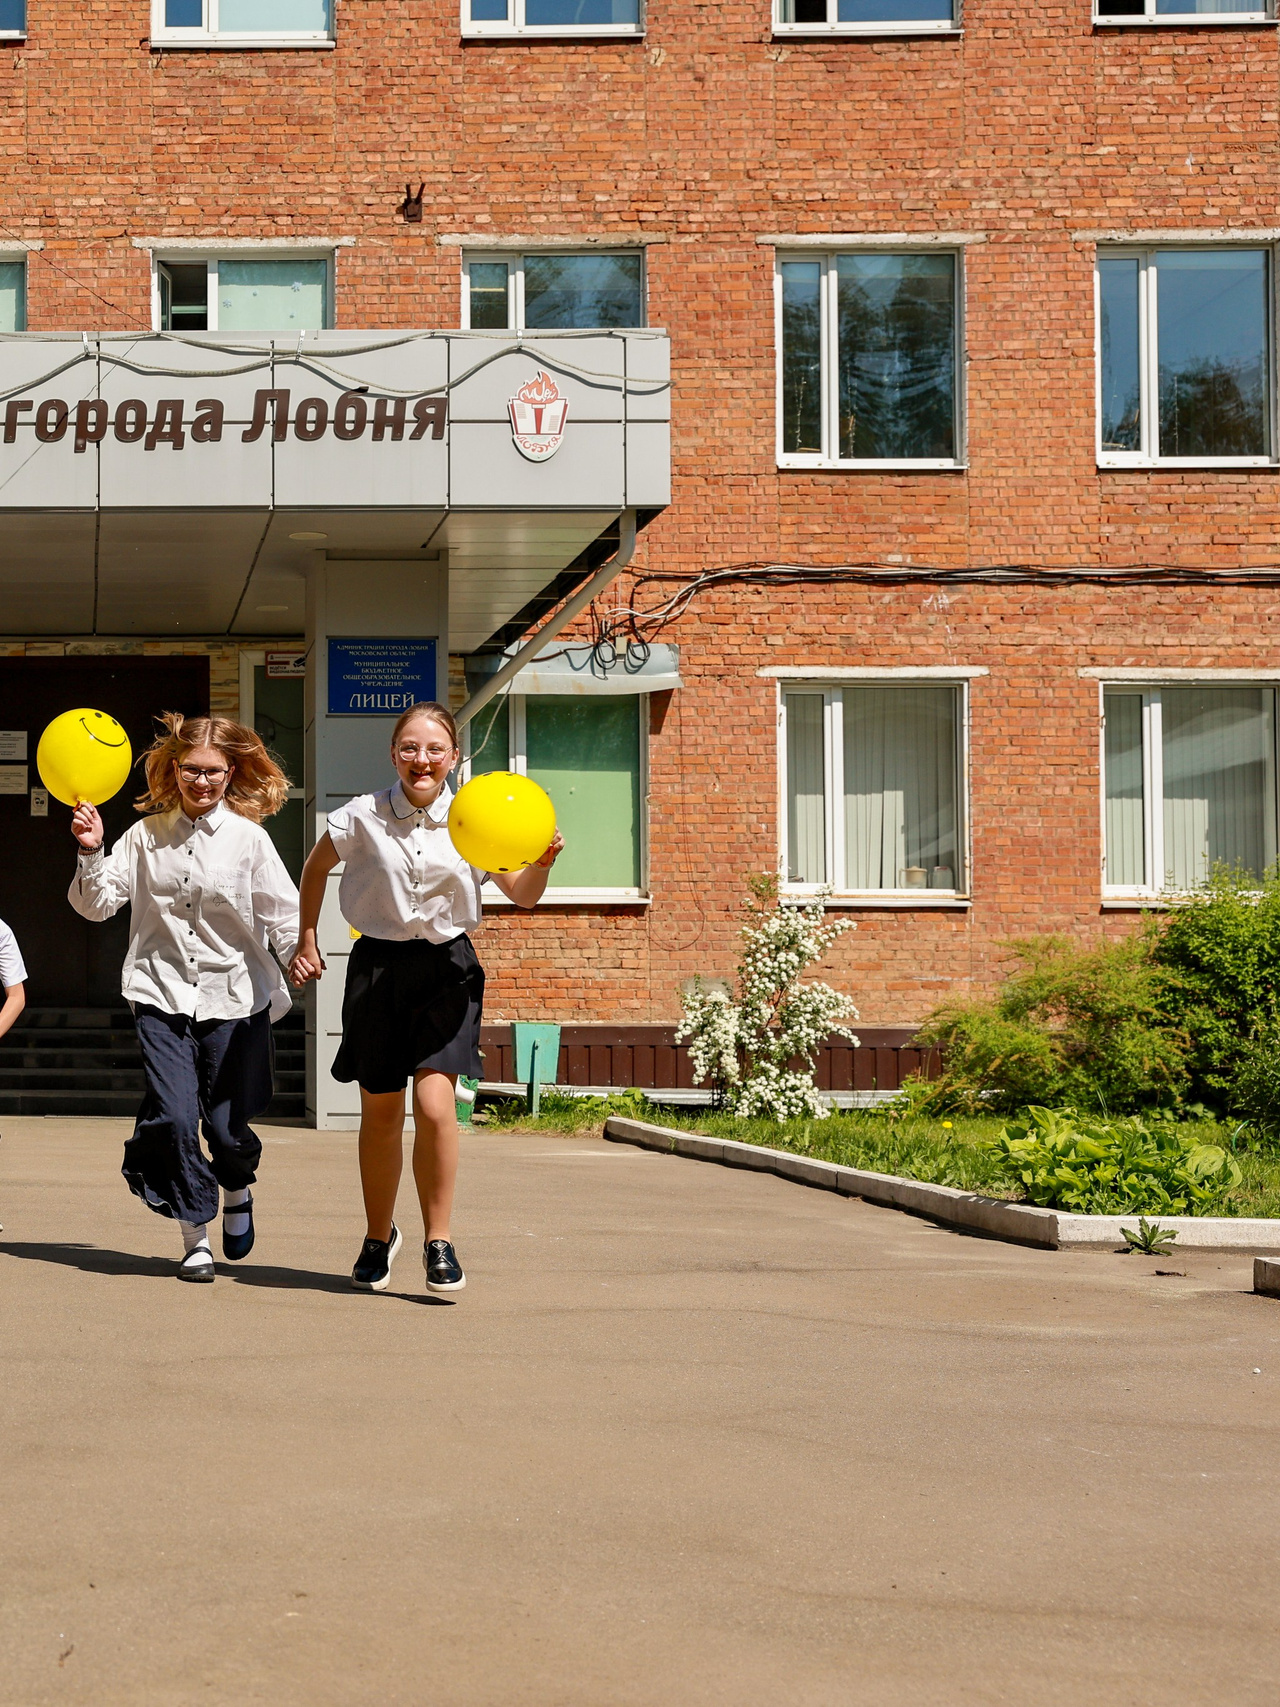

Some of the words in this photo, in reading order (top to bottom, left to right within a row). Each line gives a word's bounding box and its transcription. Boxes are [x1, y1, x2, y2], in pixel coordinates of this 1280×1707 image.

[4, 399, 225, 452] города
[242, 388, 450, 441] Лобня
[349, 691, 415, 710] ЛИЦЕЙ
